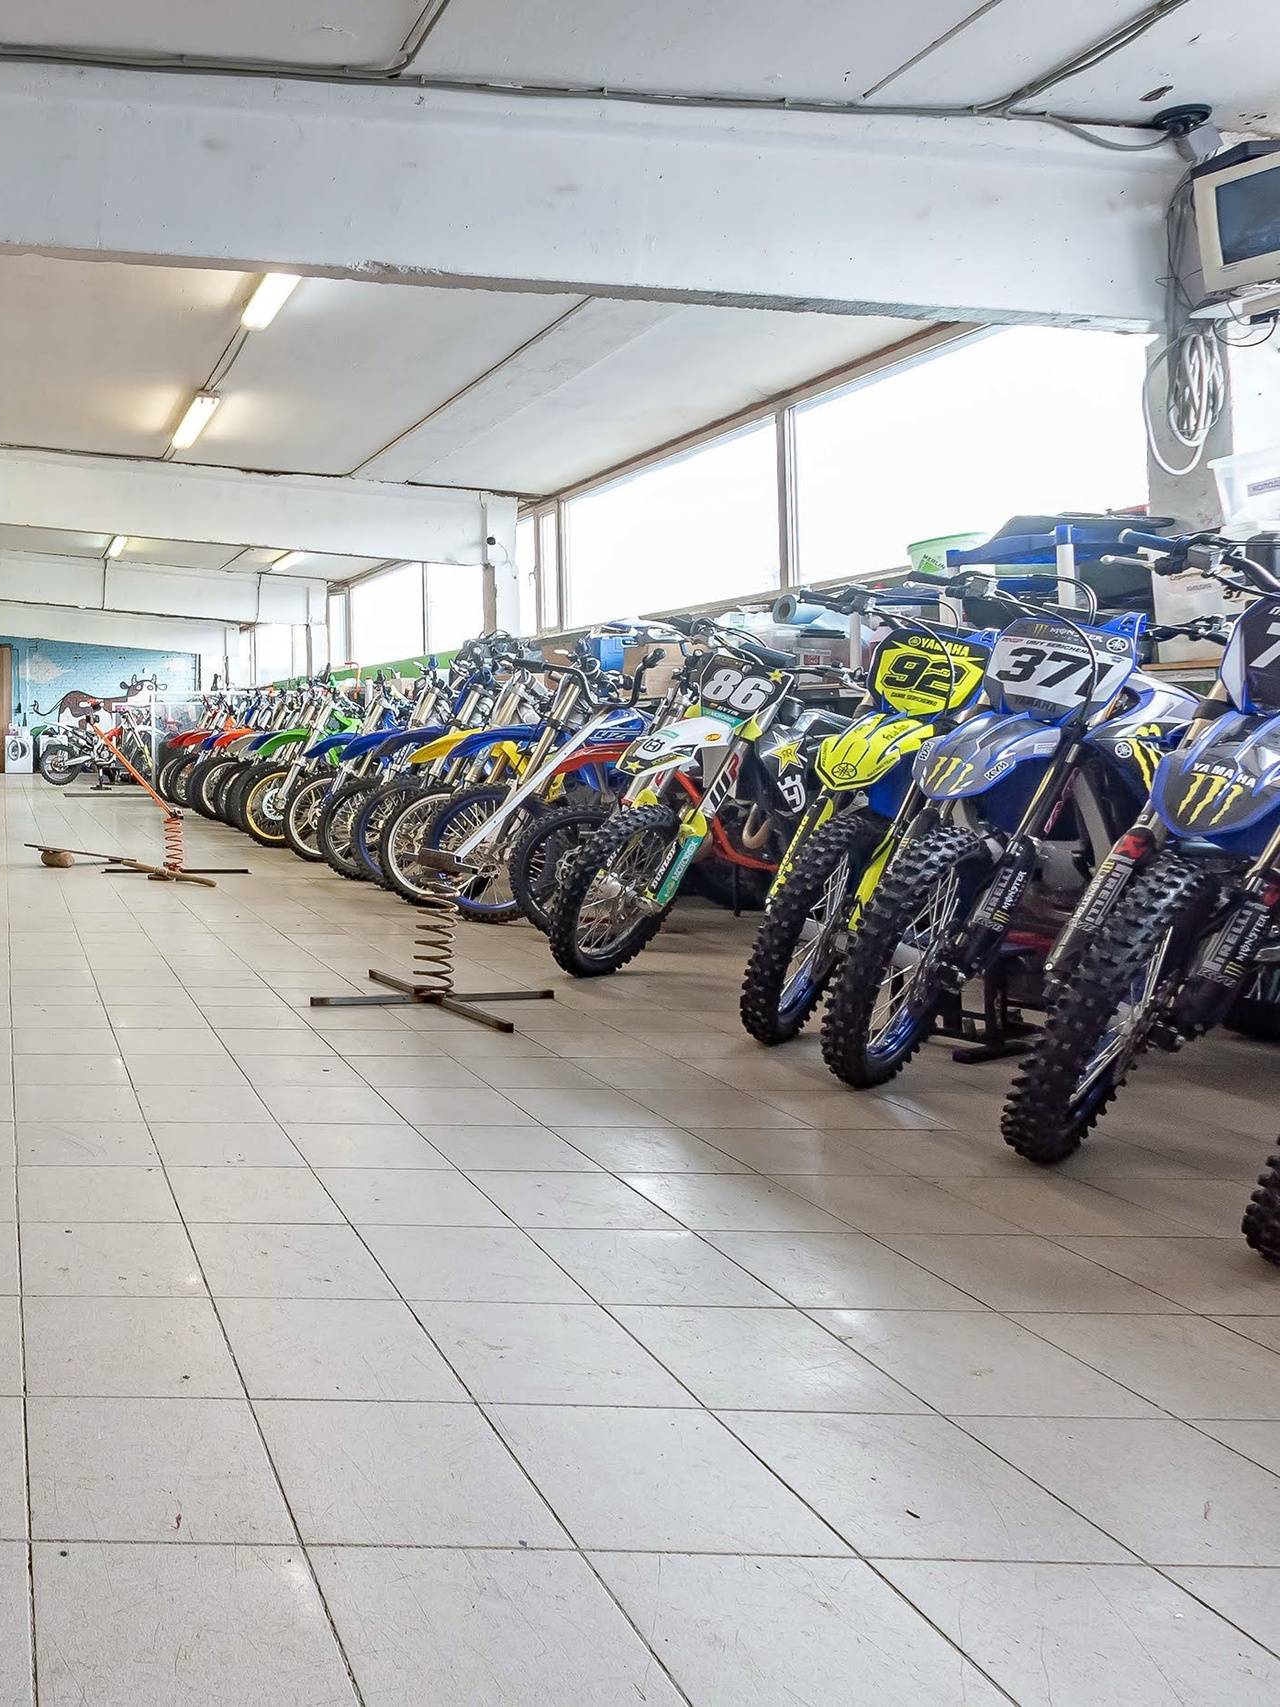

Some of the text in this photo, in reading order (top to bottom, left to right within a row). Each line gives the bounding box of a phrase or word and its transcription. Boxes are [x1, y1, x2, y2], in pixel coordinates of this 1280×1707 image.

[922, 553, 946, 570] MERLIN
[921, 638, 970, 658] YAMAHA
[702, 668, 775, 711] 86
[881, 653, 970, 700] 92
[1192, 762, 1257, 789] YAMAHA
[671, 840, 699, 882] MOTOREX
[1001, 870, 1028, 911] MONSTER
[1235, 913, 1271, 962] MONSTER
